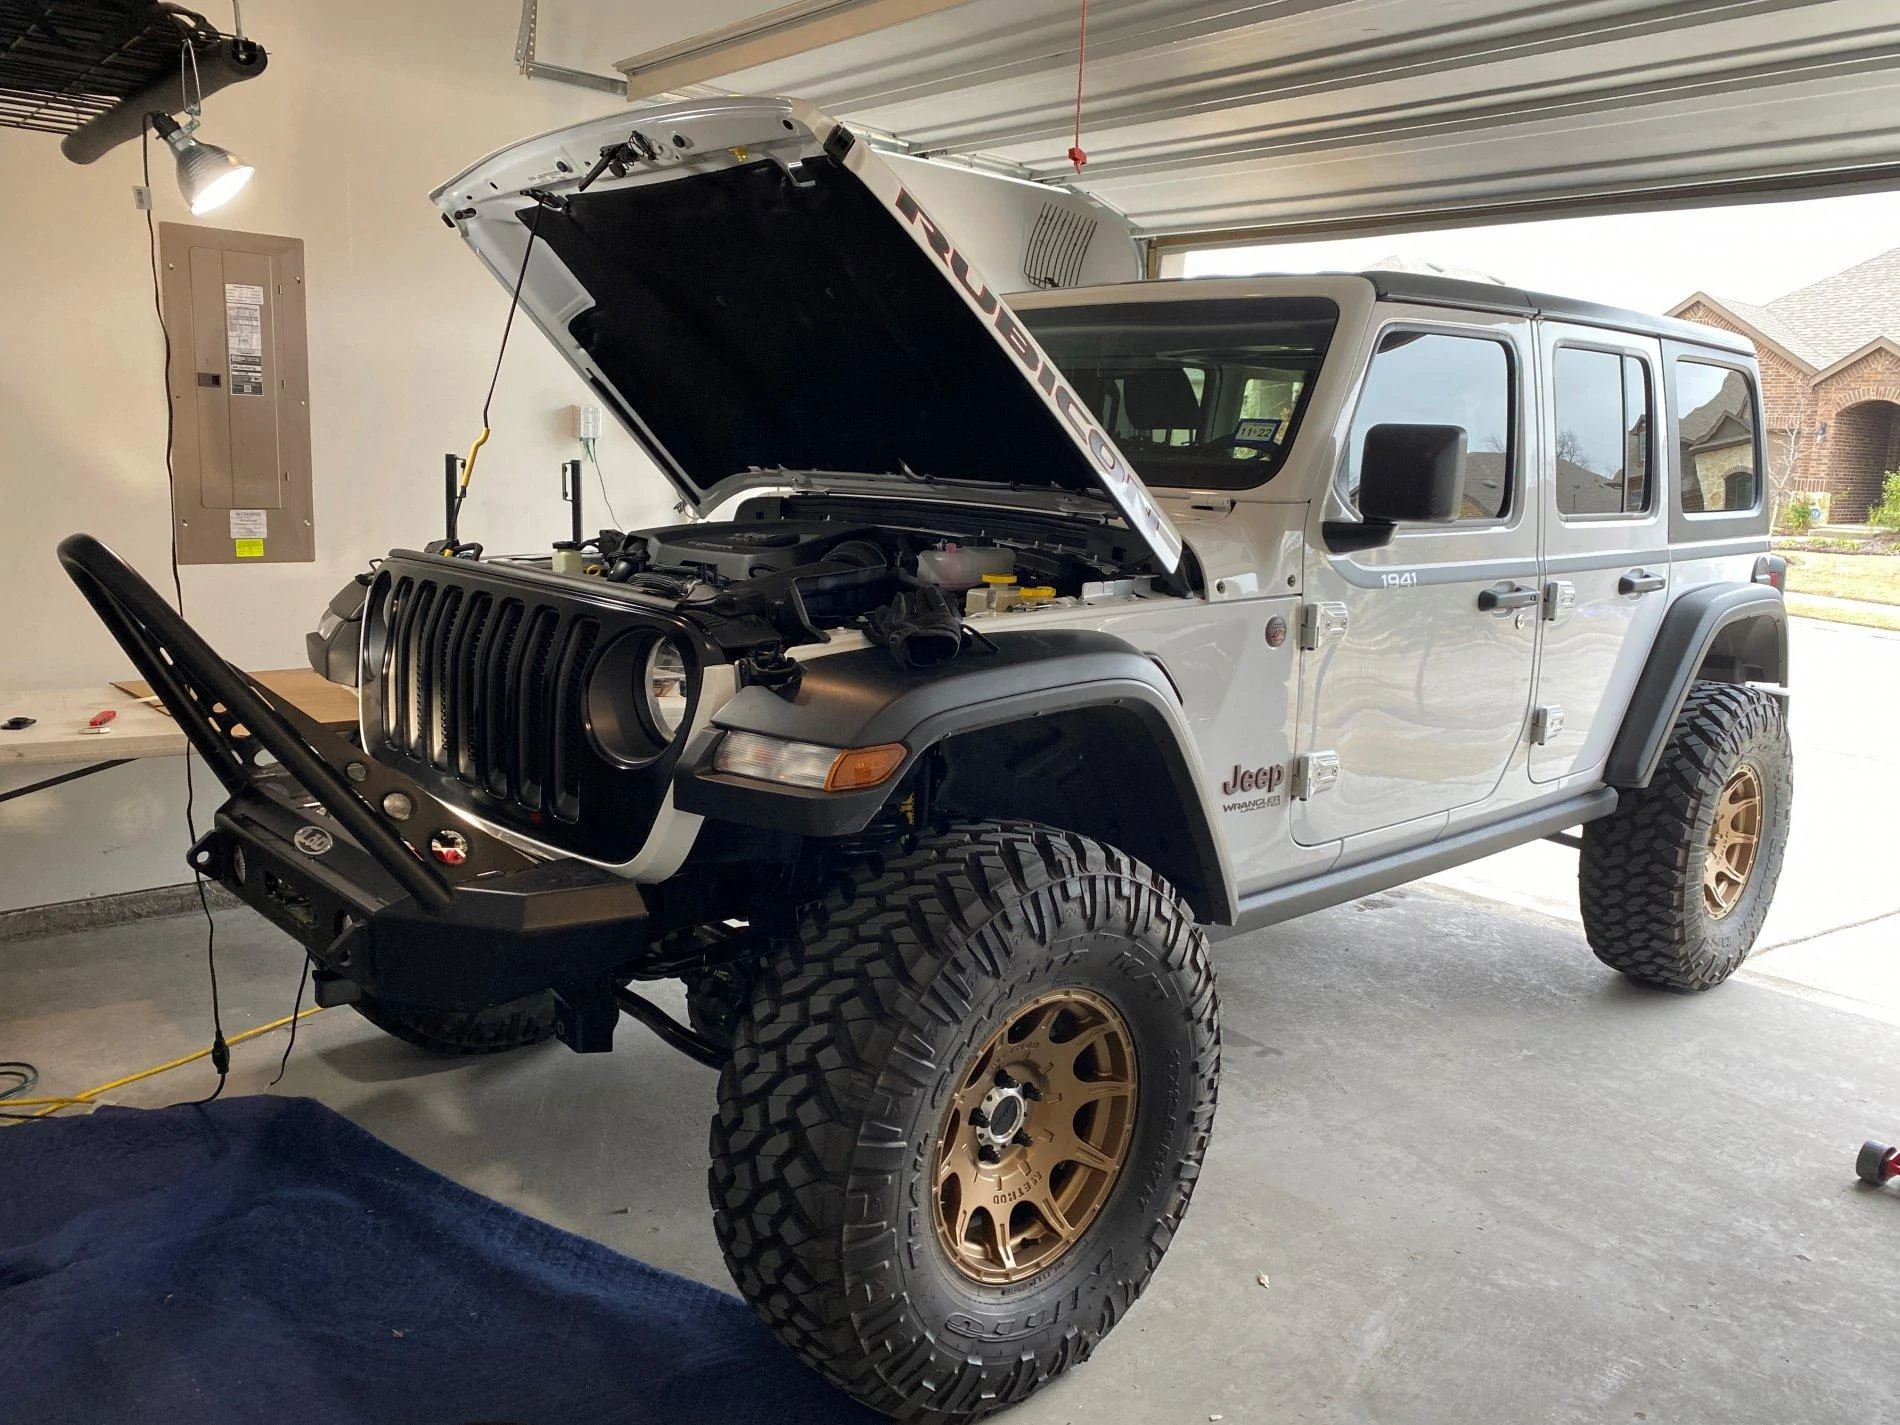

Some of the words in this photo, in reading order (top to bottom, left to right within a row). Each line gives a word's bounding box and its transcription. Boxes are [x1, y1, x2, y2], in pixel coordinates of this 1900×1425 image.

[895, 187, 1161, 537] RUBICON
[1381, 572, 1417, 589] 1941
[1223, 764, 1284, 795] Jeep
[1223, 795, 1280, 812] WRANGLER
[1240, 802, 1280, 812] UNLIMITED
[993, 1170, 1042, 1205] METHOD
